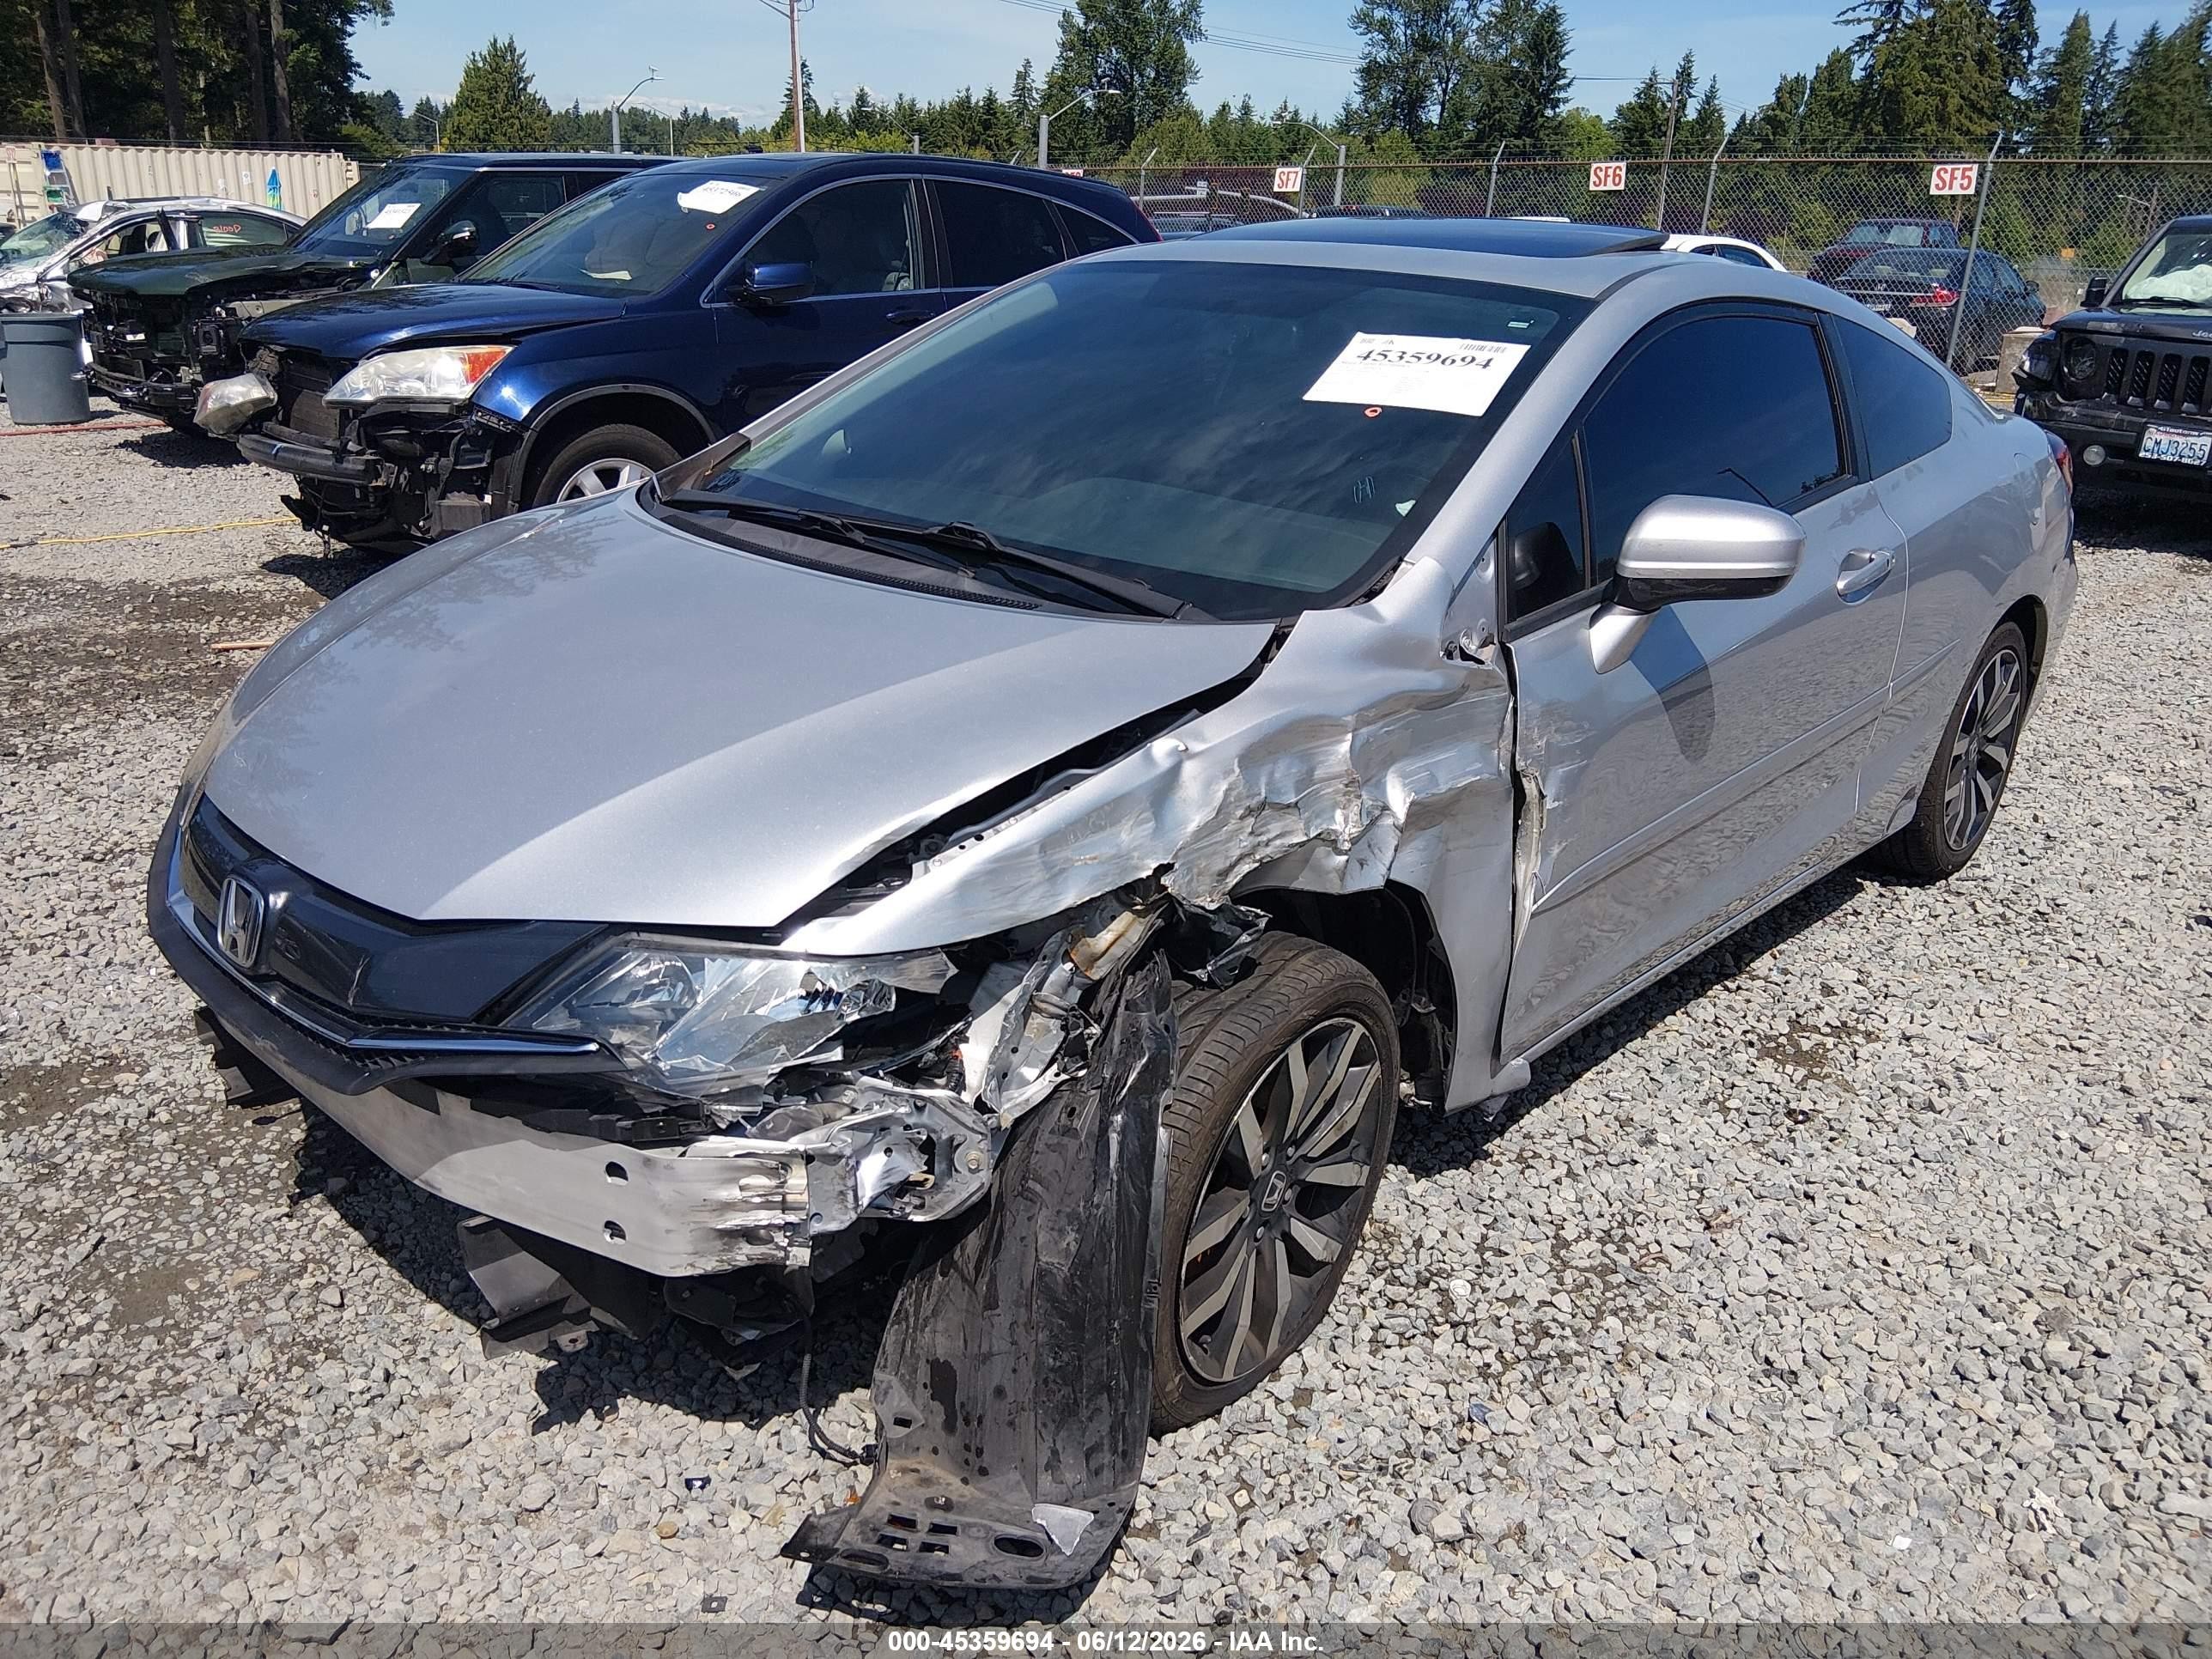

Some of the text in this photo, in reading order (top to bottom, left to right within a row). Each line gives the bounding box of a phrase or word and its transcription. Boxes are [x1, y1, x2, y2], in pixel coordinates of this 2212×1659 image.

[1277, 170, 1299, 189] SF7
[1592, 165, 1623, 188] SF6
[1934, 167, 1973, 191] SF5
[1356, 348, 1495, 370] 45359694
[2138, 452, 2207, 466] 253-507-8027
[2142, 436, 2208, 460] CMJ3255
